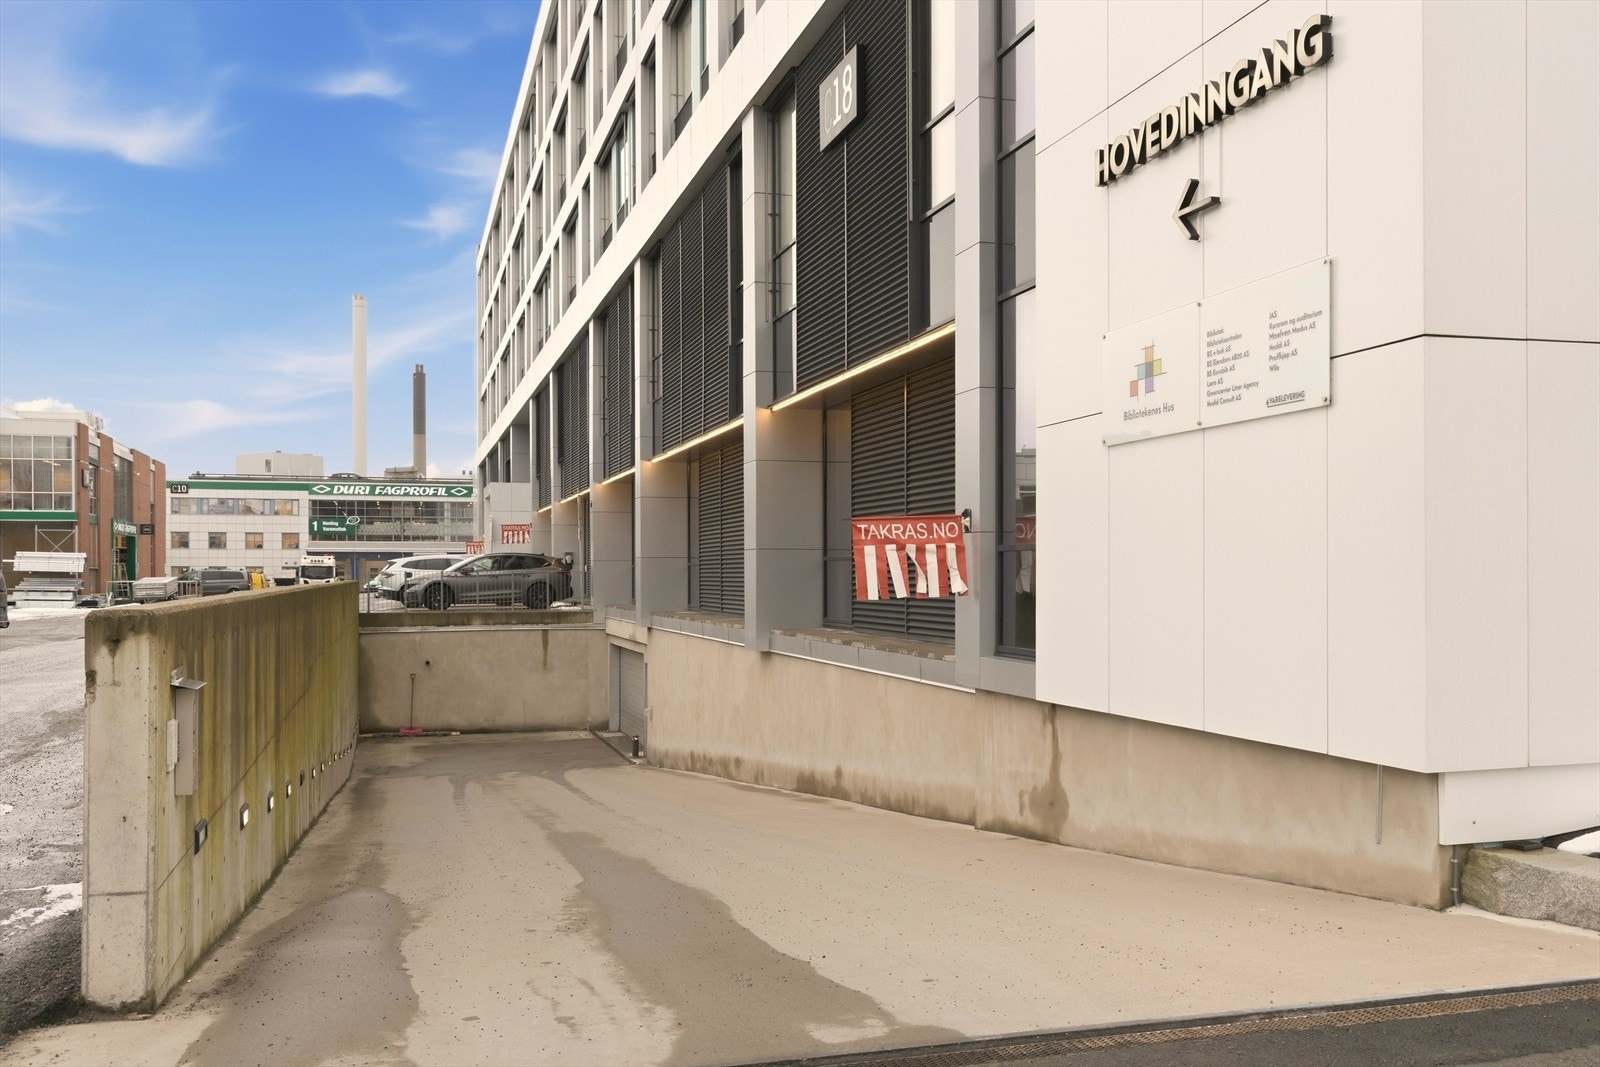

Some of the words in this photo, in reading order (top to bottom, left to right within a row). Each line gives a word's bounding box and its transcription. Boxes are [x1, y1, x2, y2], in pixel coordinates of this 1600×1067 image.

[824, 64, 853, 134] C18
[1095, 14, 1331, 187] HOVEDINNGANG
[1296, 310, 1323, 321] auditorium
[1291, 324, 1308, 333] Modus
[1309, 321, 1316, 330] AS
[1207, 328, 1224, 338] Bibliotek
[1283, 339, 1290, 348] AS
[1207, 350, 1213, 358] BS
[1225, 345, 1231, 353] AS
[1243, 350, 1249, 358] AS
[1290, 348, 1298, 357] AS
[1229, 364, 1235, 372] AS
[1242, 381, 1259, 390] Agency
[1269, 391, 1305, 403] VARELEVERING
[1123, 406, 1161, 421] Bibliotekenes
[1162, 402, 1175, 413] Hus
[332, 485, 370, 495] DURI
[374, 486, 448, 496] FAGPROFIL
[312, 520, 318, 531] 1
[857, 522, 959, 540] TAKRAS.NO
